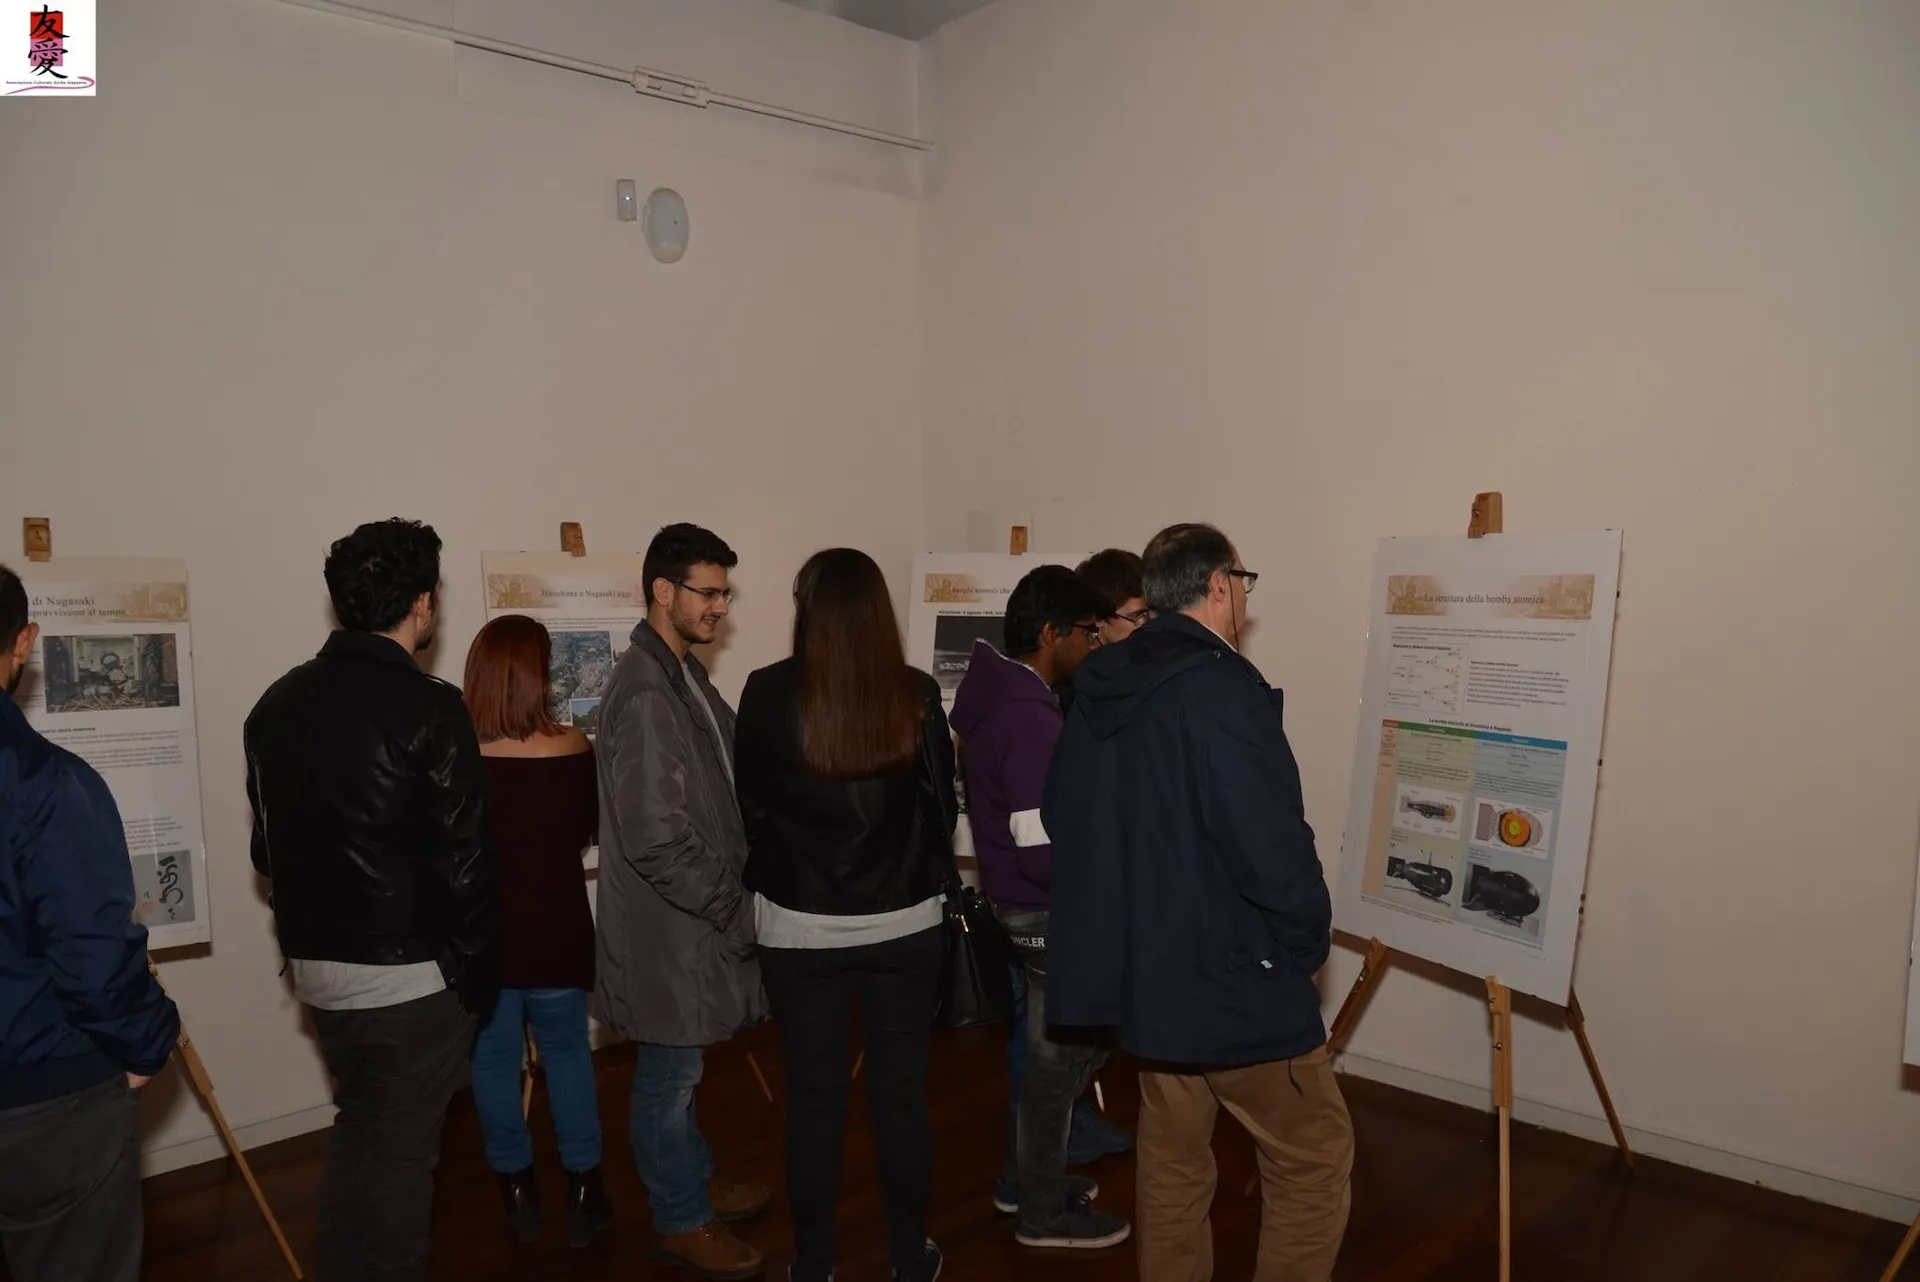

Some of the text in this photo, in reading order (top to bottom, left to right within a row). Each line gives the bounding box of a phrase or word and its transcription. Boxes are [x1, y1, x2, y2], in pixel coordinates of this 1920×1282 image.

[585, 589, 616, 599] Nagasaki
[1424, 592, 1434, 602] La
[1466, 593, 1484, 603] della
[1486, 594, 1511, 604] bomba
[1513, 595, 1544, 604] atomica
[32, 596, 95, 608] di Nagasaki
[28, 608, 127, 618] opravvivono al tempo
[1010, 936, 1046, 948] NCLER
